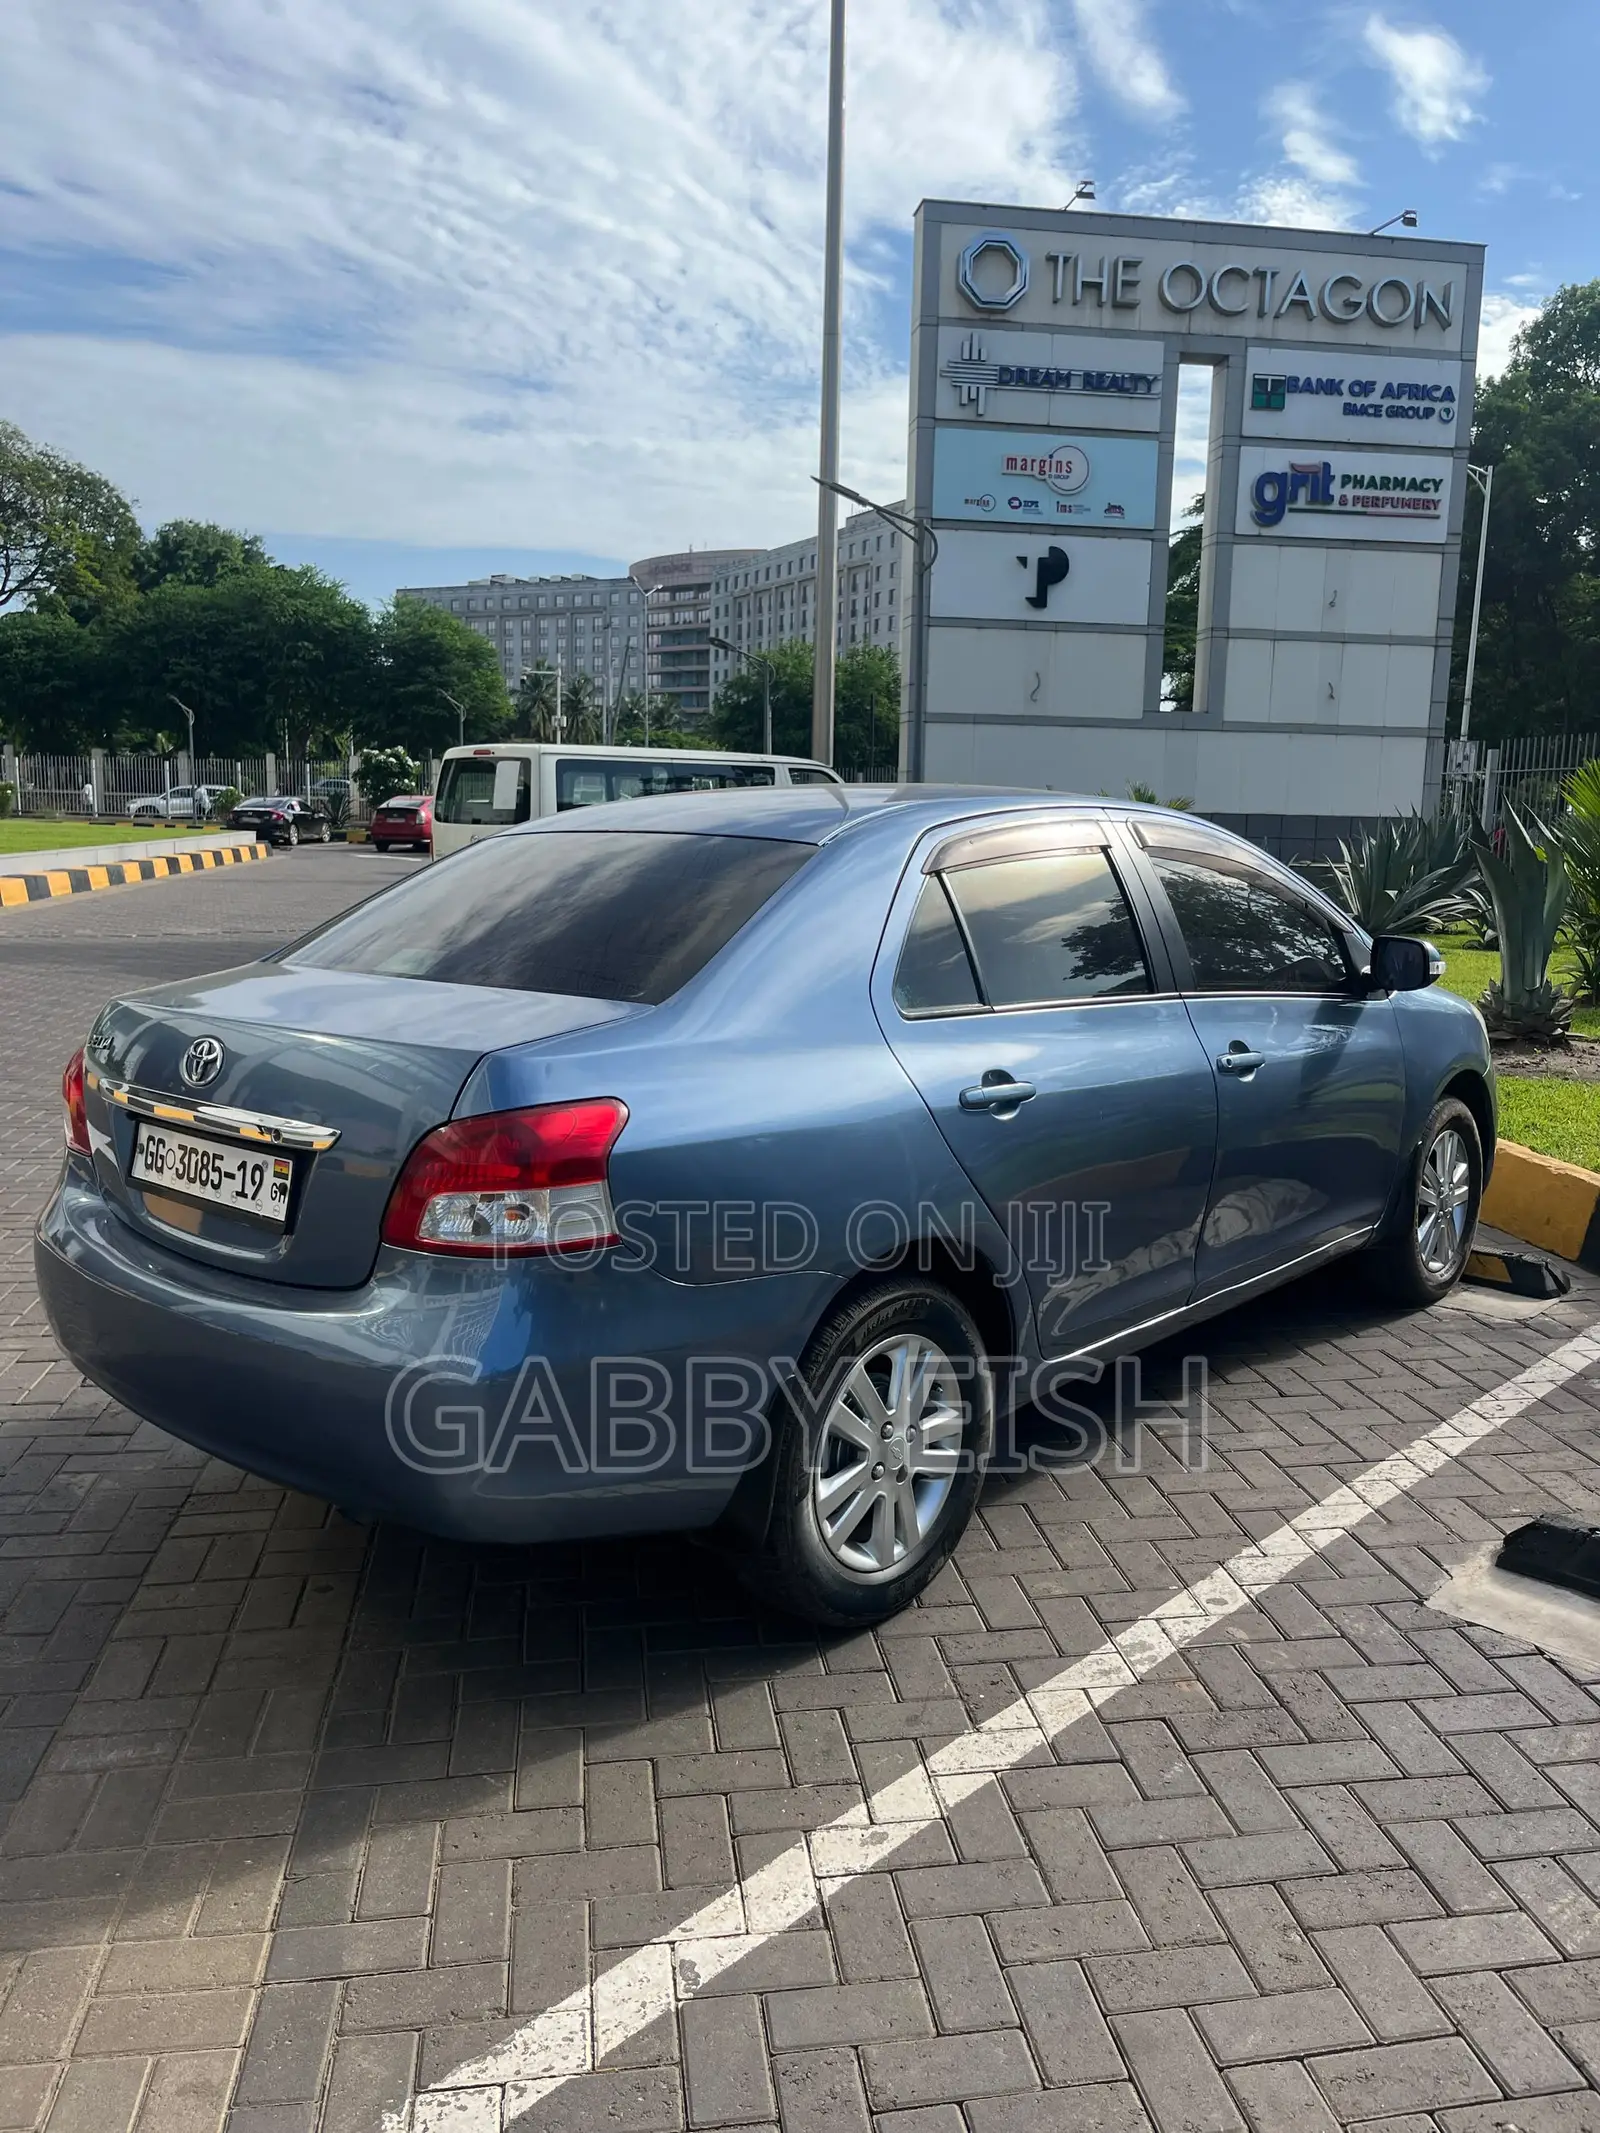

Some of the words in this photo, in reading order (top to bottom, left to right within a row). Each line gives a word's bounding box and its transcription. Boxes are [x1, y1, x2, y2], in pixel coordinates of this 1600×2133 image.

[1046, 251, 1143, 309] THE
[1158, 261, 1453, 330] OCTAGON
[999, 365, 1072, 389] DREAM
[1082, 371, 1160, 393] REALTY
[1286, 375, 1344, 396] BANK
[1349, 379, 1377, 397] OF
[1381, 382, 1455, 403] AFRICA
[1342, 402, 1383, 418] BMCE
[1386, 405, 1436, 420] GROUP
[1006, 455, 1072, 476] margins
[1253, 461, 1335, 527] grit
[1340, 474, 1443, 493] PHARMACY
[1339, 494, 1348, 506] &
[1352, 495, 1441, 511] PERFUMERY
